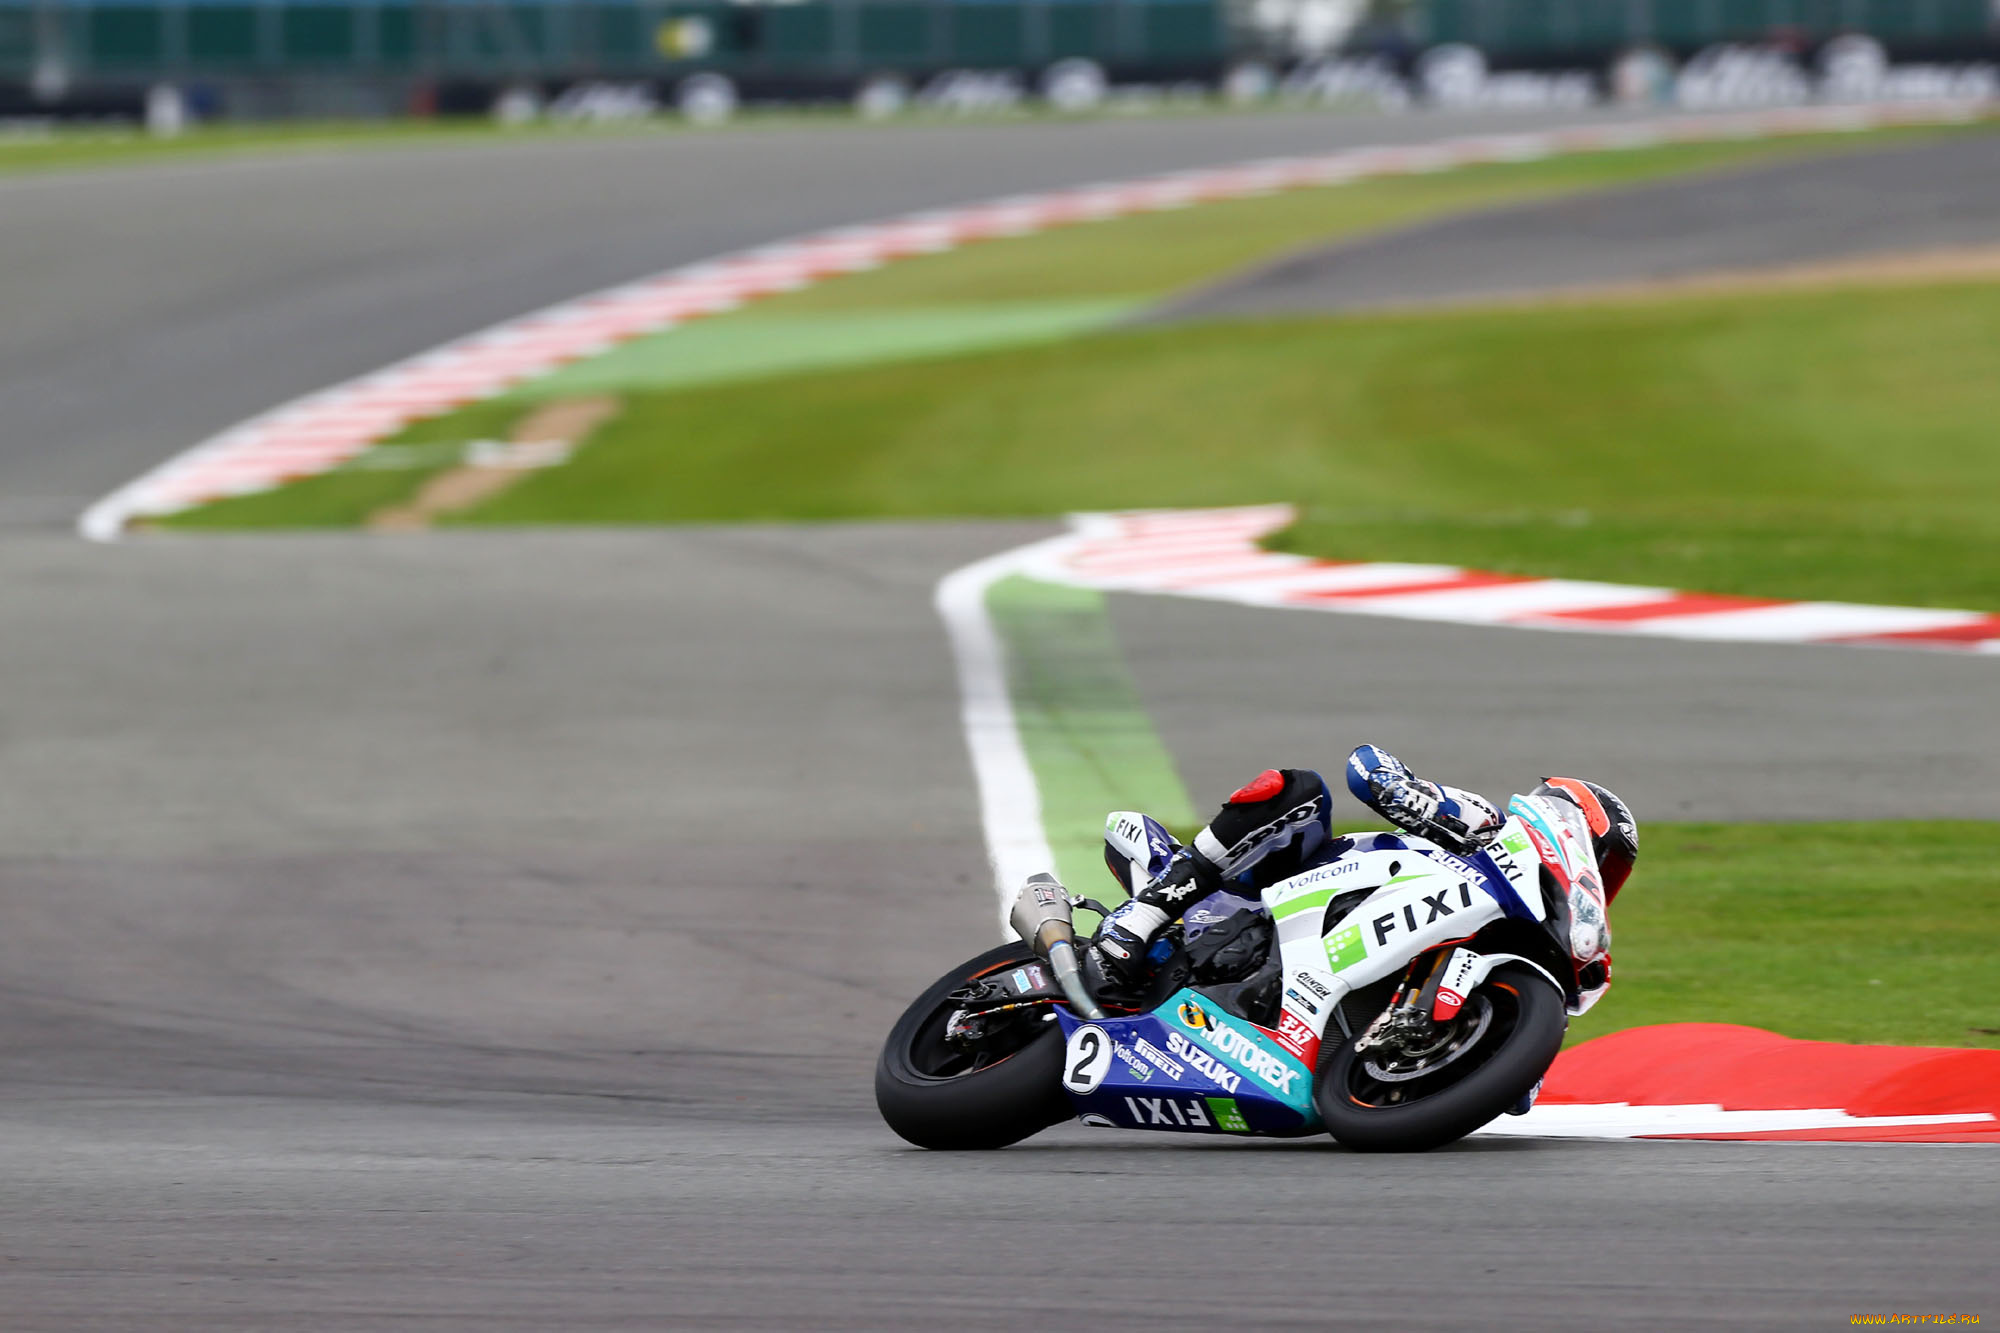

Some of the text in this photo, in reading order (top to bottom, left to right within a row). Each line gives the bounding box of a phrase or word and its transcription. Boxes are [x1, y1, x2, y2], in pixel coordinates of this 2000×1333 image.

[1116, 819, 1142, 843] FIXI
[1225, 797, 1323, 866] SPIDI
[1288, 861, 1359, 889] Voltcom
[1428, 850, 1489, 887] SUZUKI
[1486, 842, 1523, 882] FIXI
[1373, 882, 1472, 947] FIXI
[1071, 1032, 1100, 1084] 2
[1112, 1040, 1151, 1075] Voltcom
[1133, 1037, 1184, 1081] PIRELLI
[1166, 1032, 1241, 1094] SUZUKI
[1200, 1014, 1298, 1095] MOTOREX
[1124, 1096, 1211, 1127] FIXI
